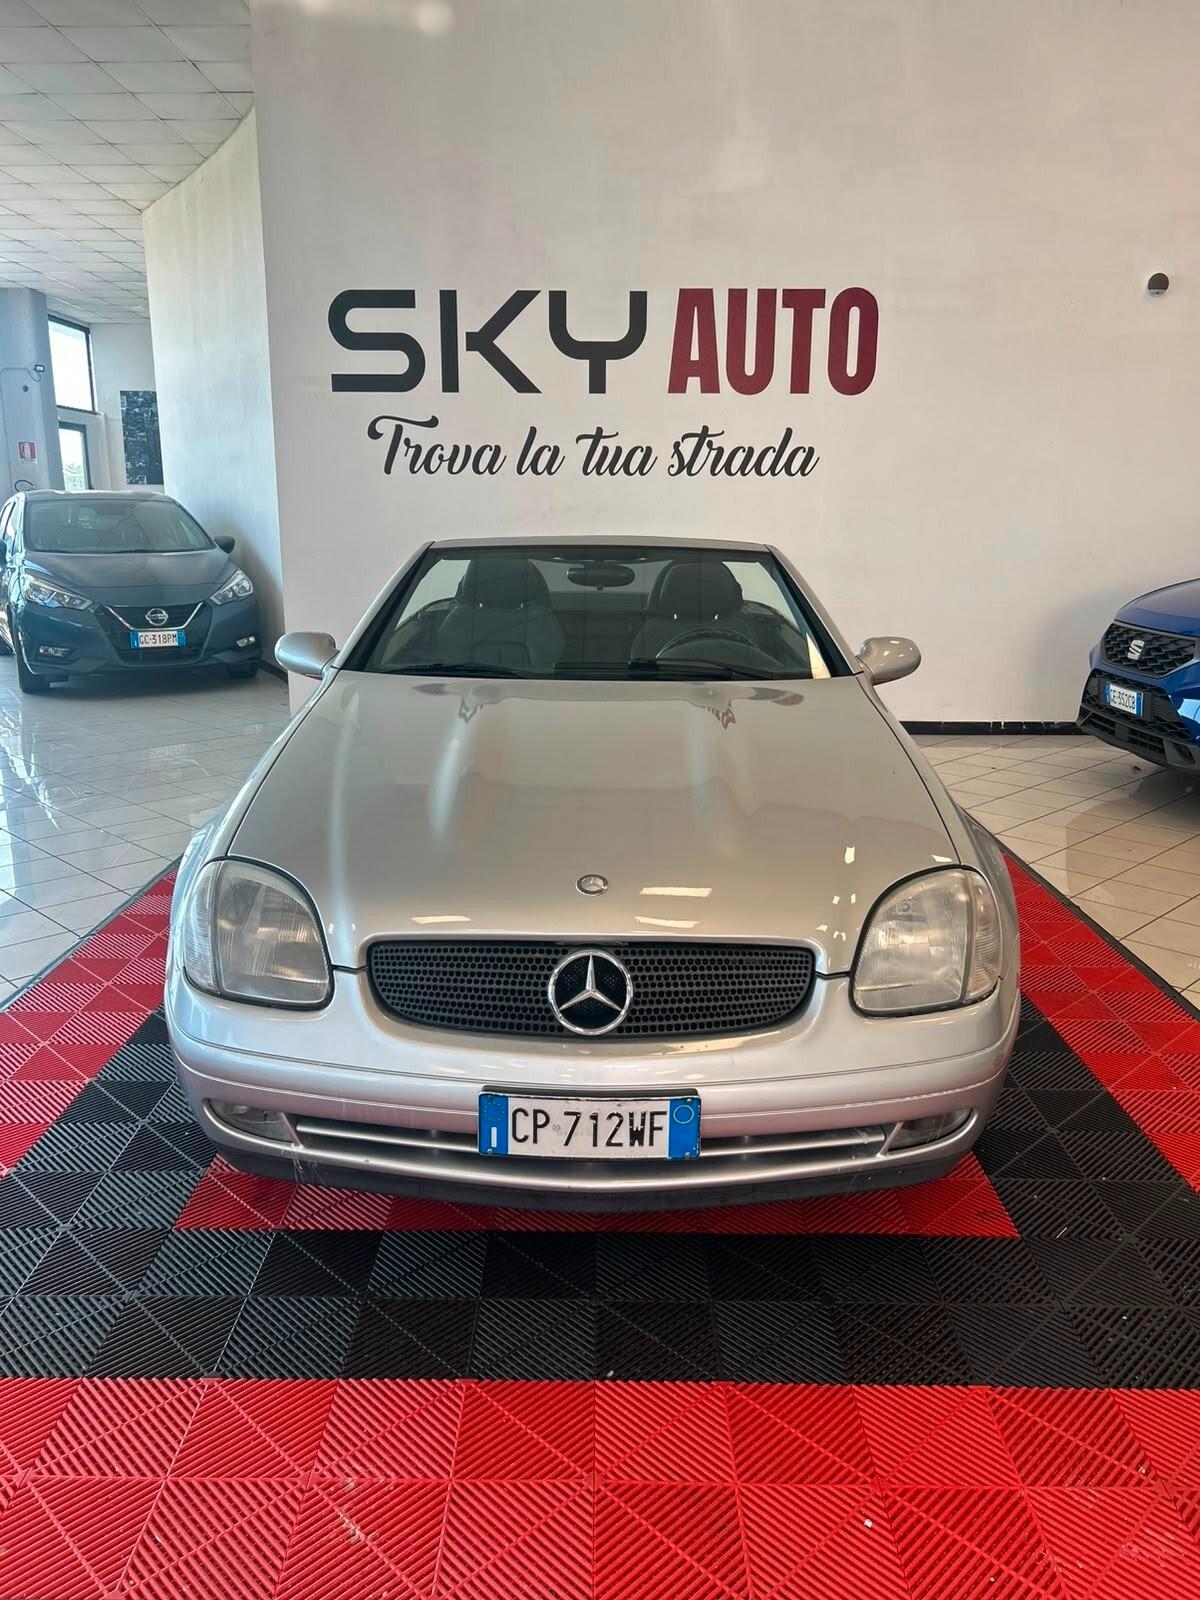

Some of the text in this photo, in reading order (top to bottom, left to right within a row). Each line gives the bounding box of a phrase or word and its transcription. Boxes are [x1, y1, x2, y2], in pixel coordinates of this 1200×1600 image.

[328, 286, 879, 396] SKY AUTO
[367, 414, 820, 477] Trova la tua strada
[511, 1107, 668, 1148] CP 712WF
